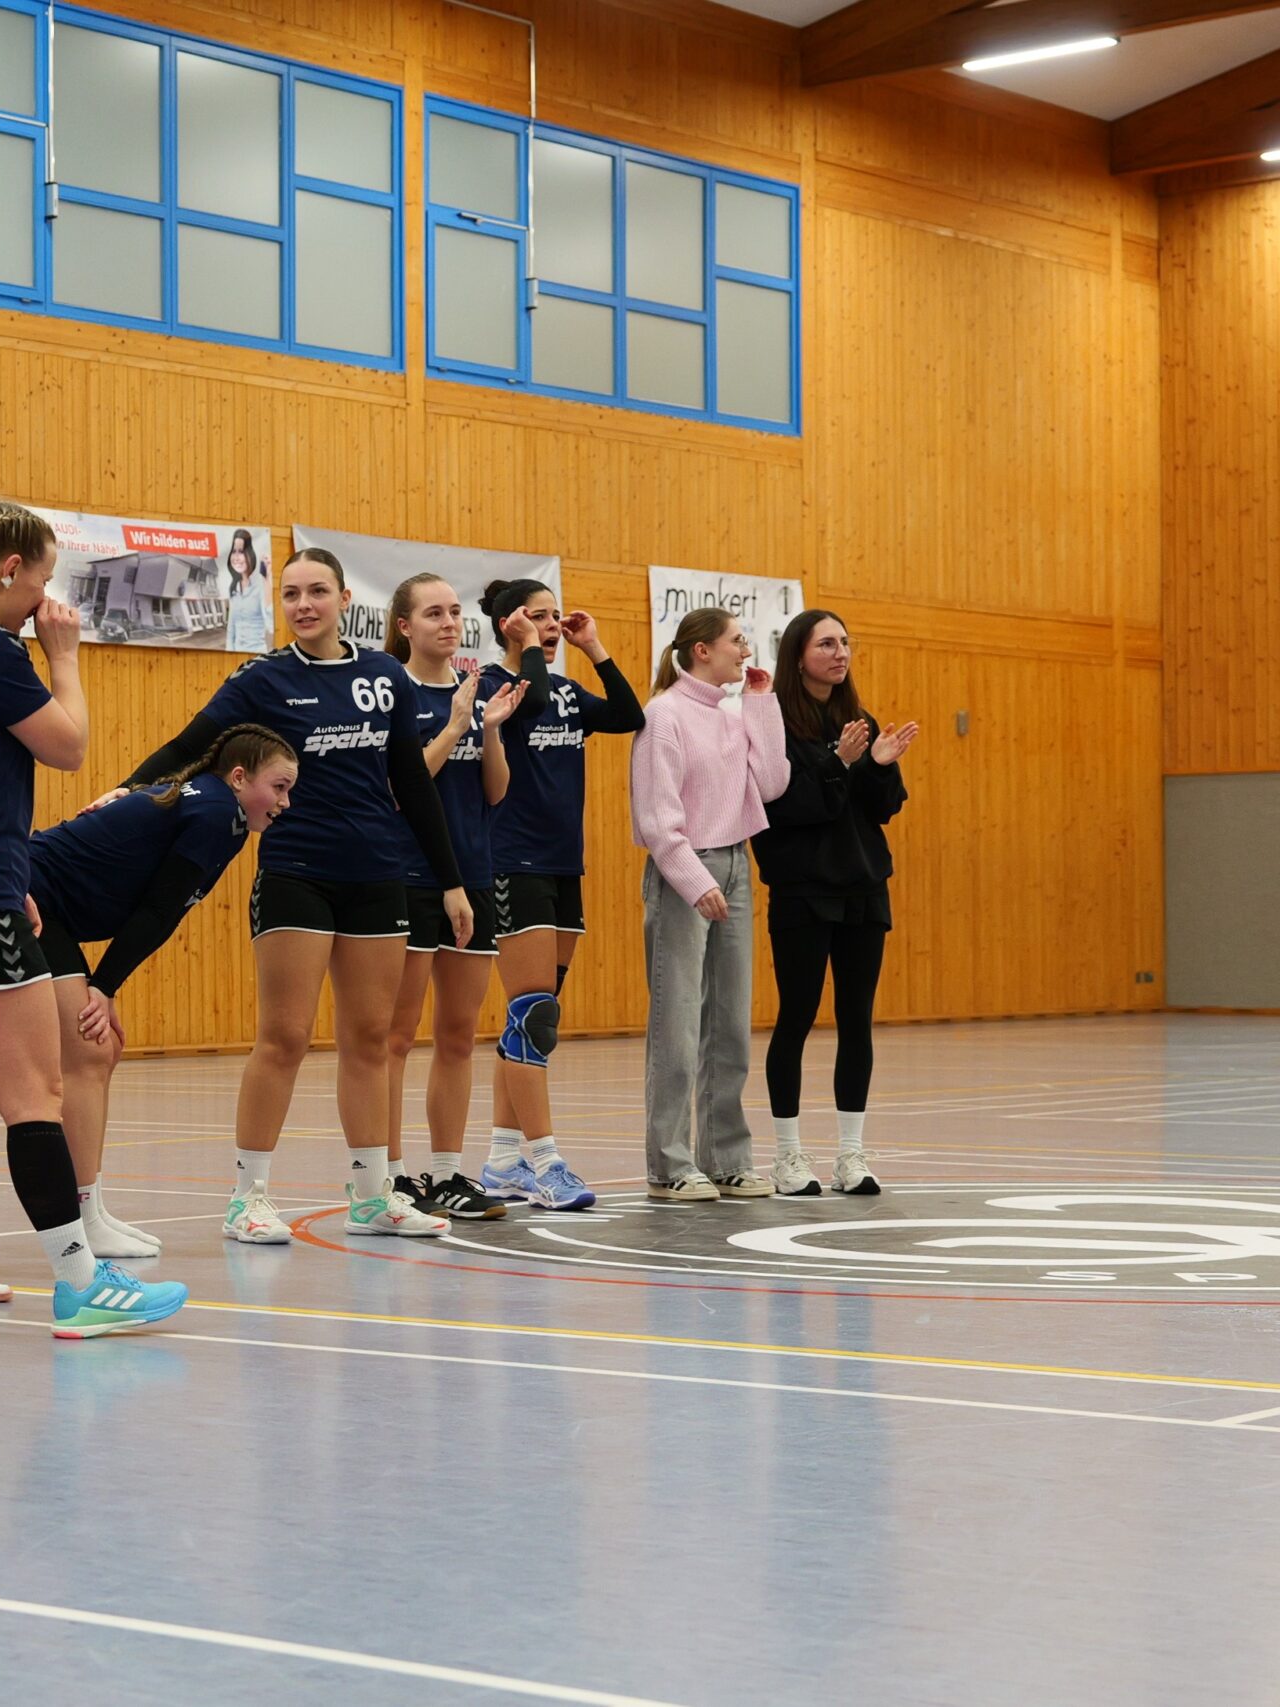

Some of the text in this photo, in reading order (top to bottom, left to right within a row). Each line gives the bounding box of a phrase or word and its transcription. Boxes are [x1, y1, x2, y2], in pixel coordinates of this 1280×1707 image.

[67, 540, 90, 552] Ihrer
[130, 530, 209, 550] Wir bilden aus!
[659, 577, 757, 622] munkert
[351, 676, 395, 713] 66
[549, 684, 580, 718] 25
[313, 724, 361, 735] Autohaus
